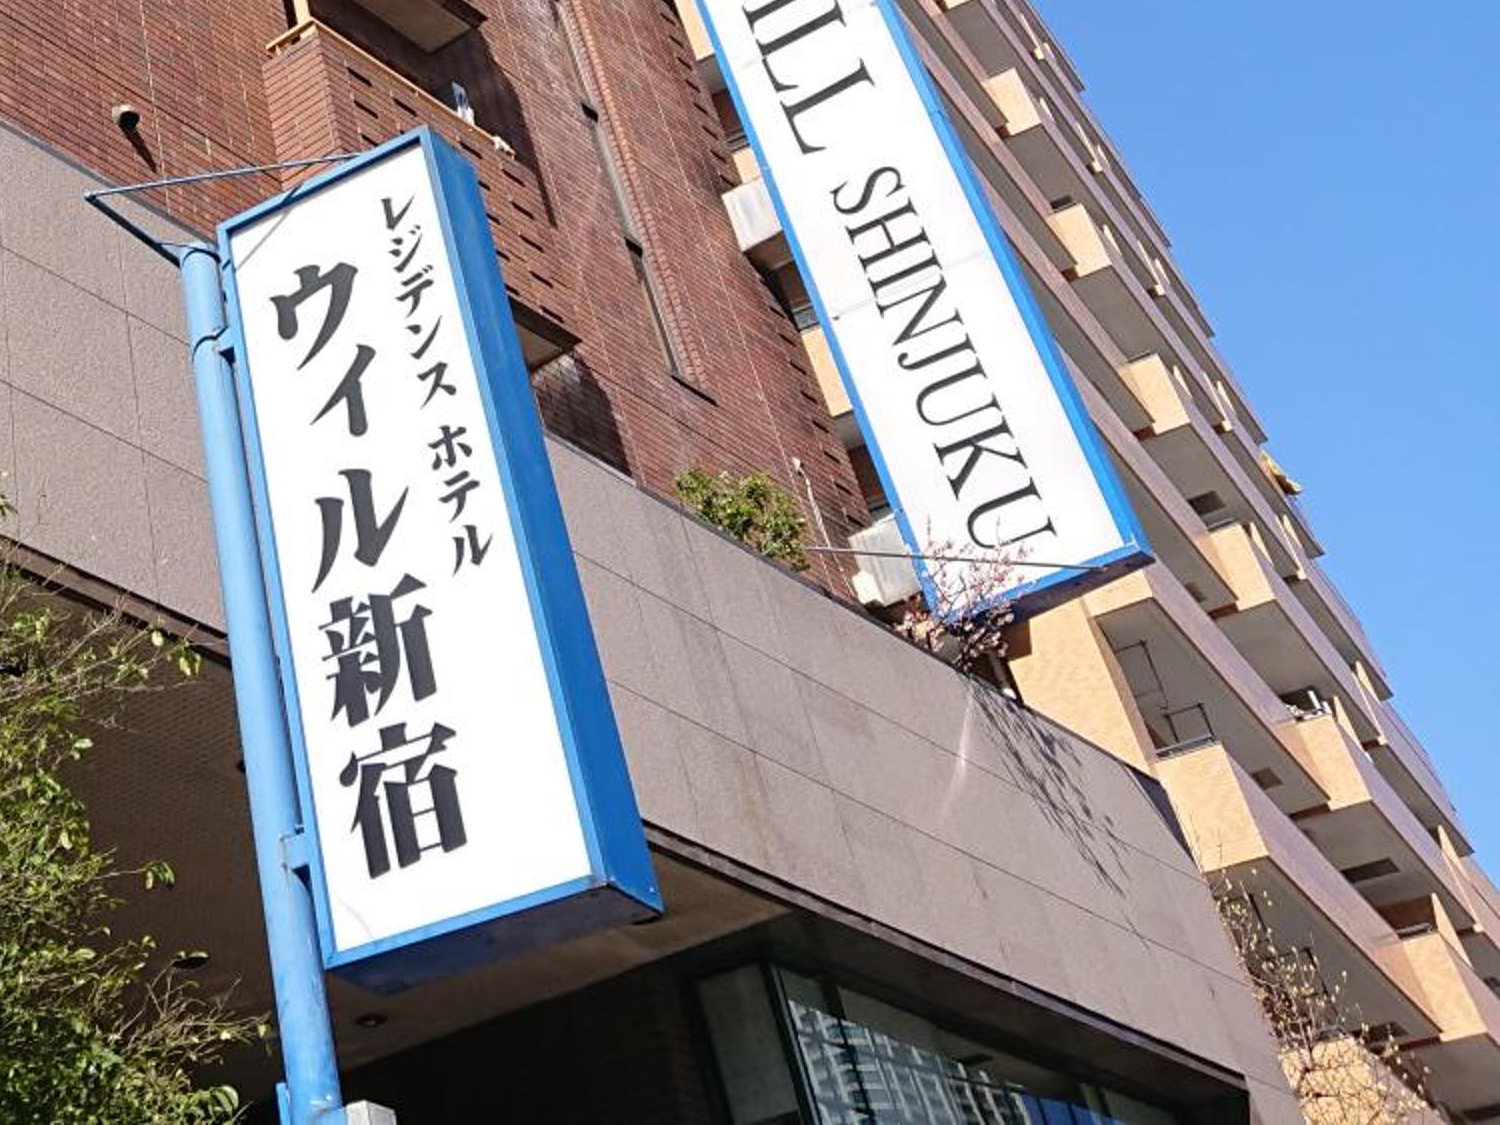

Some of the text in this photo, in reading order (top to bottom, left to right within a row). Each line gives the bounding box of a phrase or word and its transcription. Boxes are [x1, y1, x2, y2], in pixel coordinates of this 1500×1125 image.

[381, 195, 493, 575] レジデンス ホテル
[831, 165, 1057, 552] SHINJUKU
[269, 260, 469, 880] ウィル新宿
